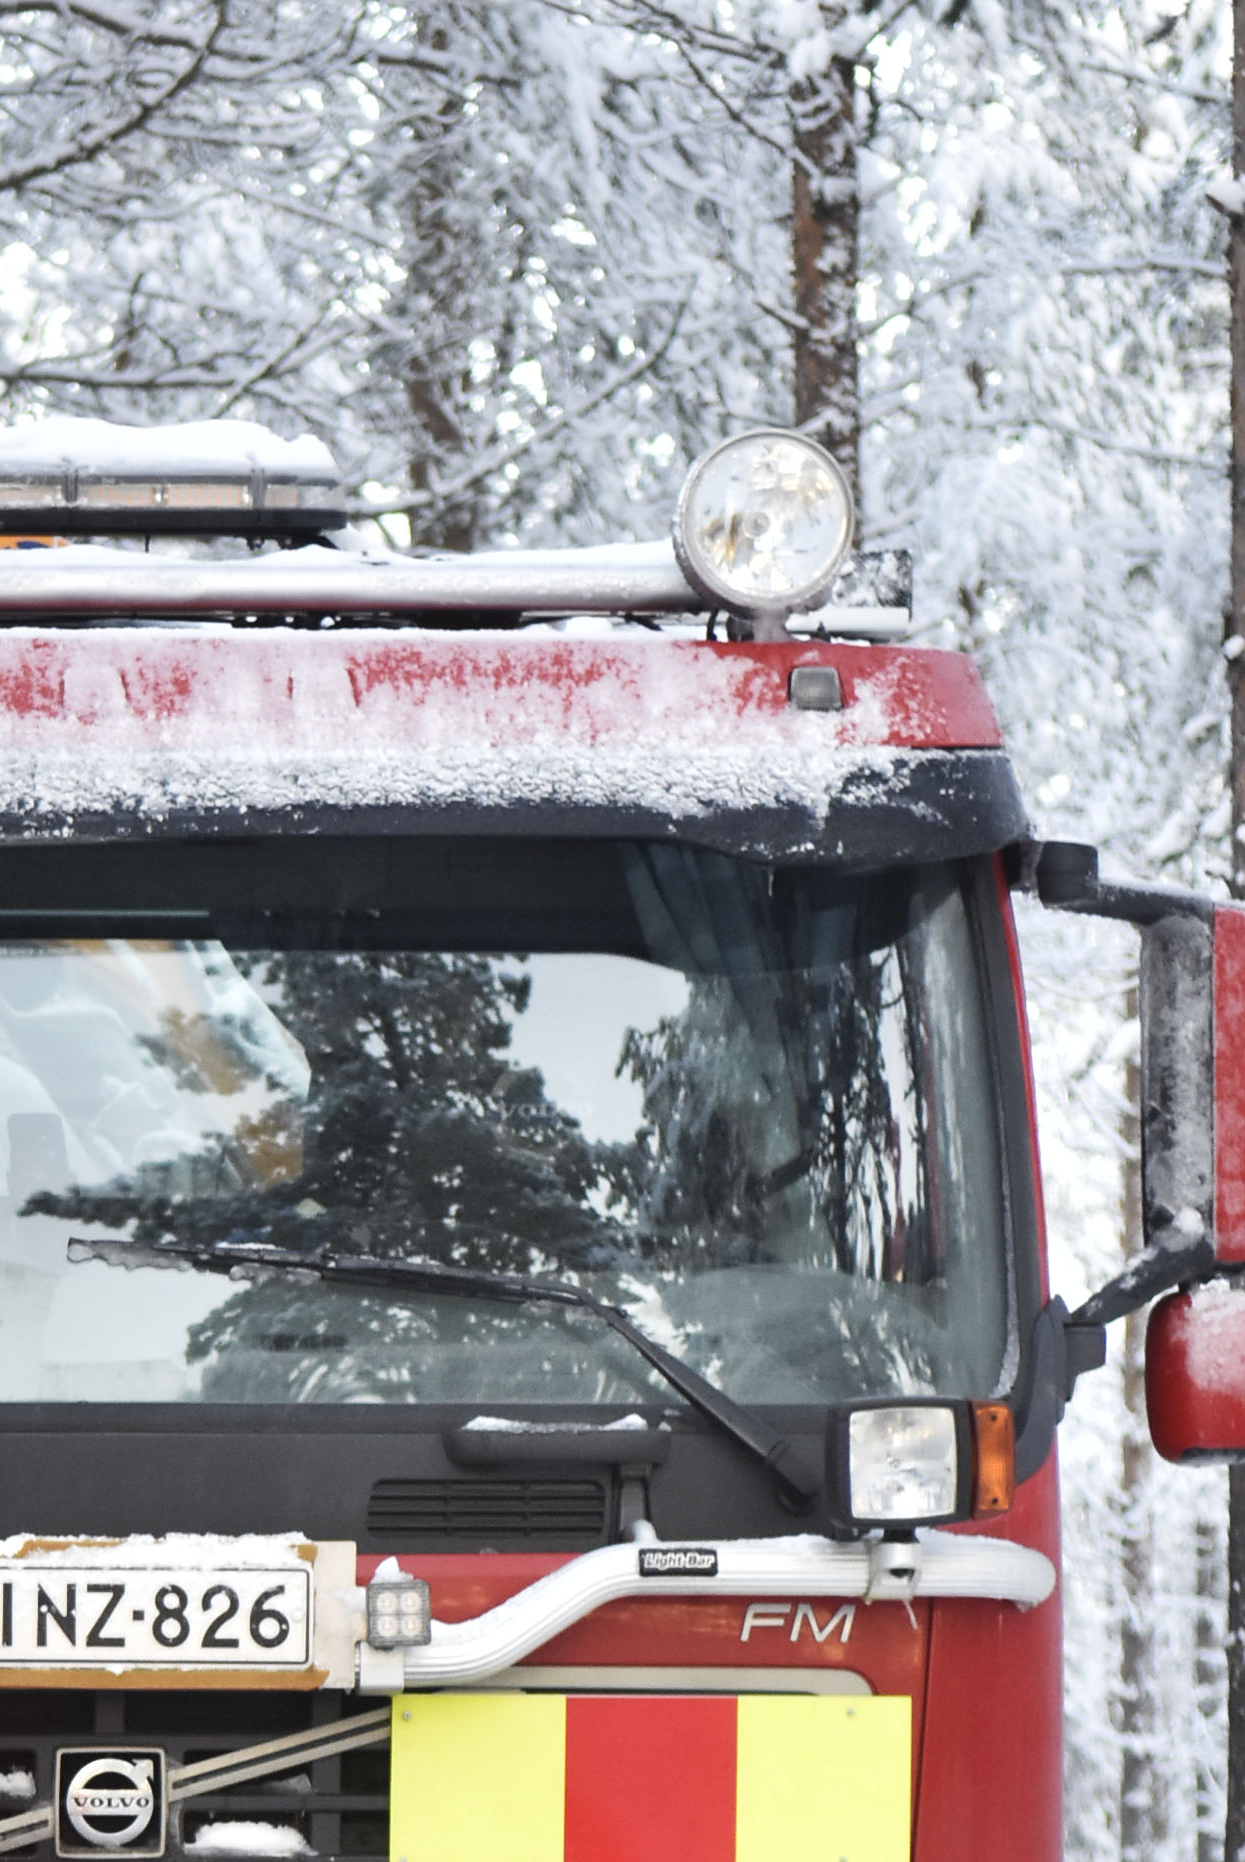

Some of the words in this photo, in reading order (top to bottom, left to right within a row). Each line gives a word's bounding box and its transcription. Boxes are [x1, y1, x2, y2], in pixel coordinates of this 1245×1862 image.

[645, 1552, 684, 1570] Light
[685, 1552, 715, 1569] Bar
[2, 1583, 290, 1648] INZ-826
[740, 1603, 856, 1643] FM
[73, 1797, 150, 1808] VOLVO
